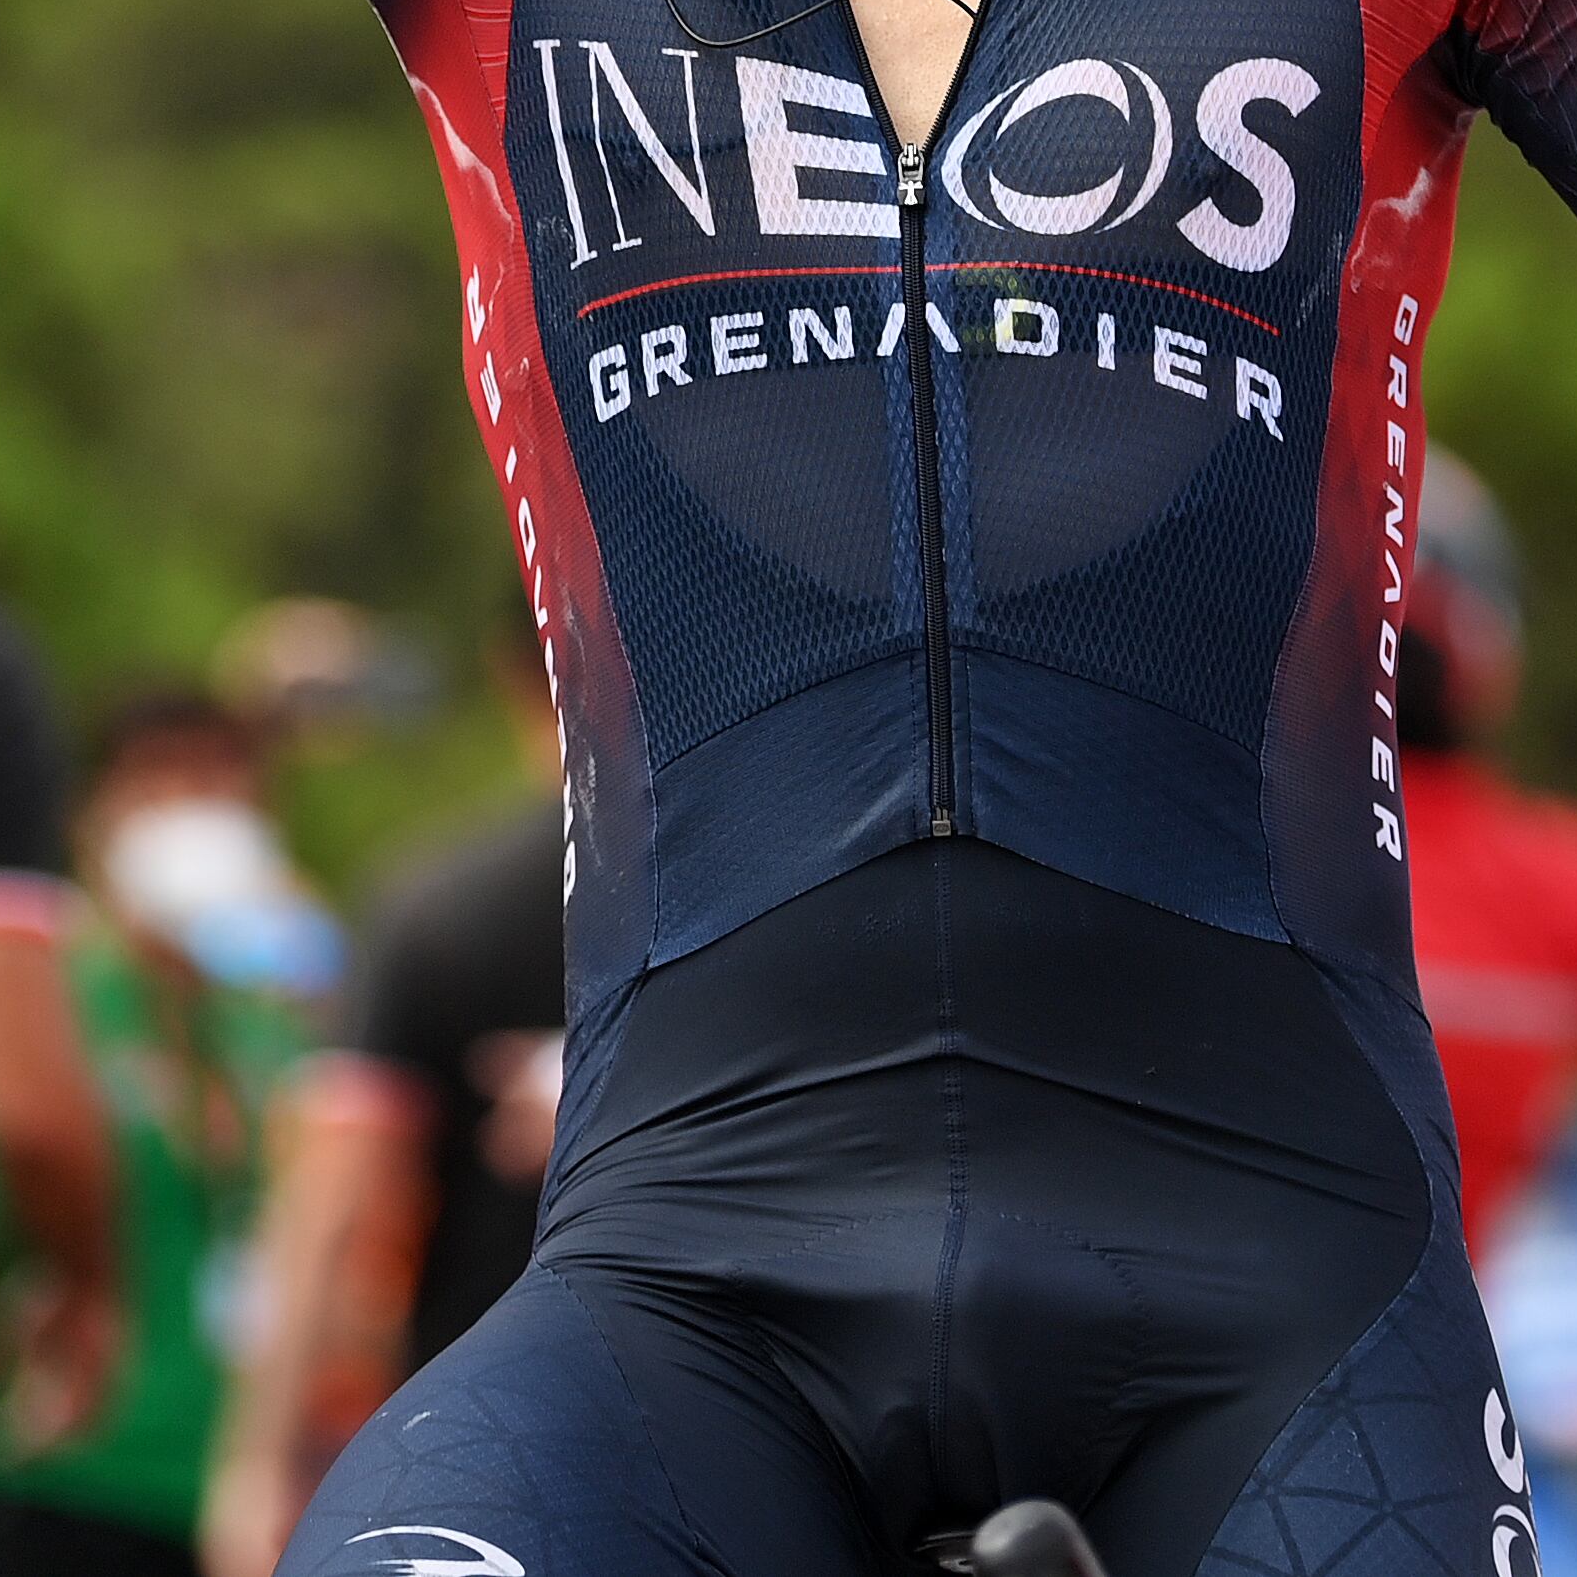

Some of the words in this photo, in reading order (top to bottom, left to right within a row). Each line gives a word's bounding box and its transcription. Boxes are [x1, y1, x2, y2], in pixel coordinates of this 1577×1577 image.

[532, 39, 1322, 272] INEOS
[588, 298, 1286, 443] GRENADIER
[1371, 292, 1419, 863] GRENADIER
